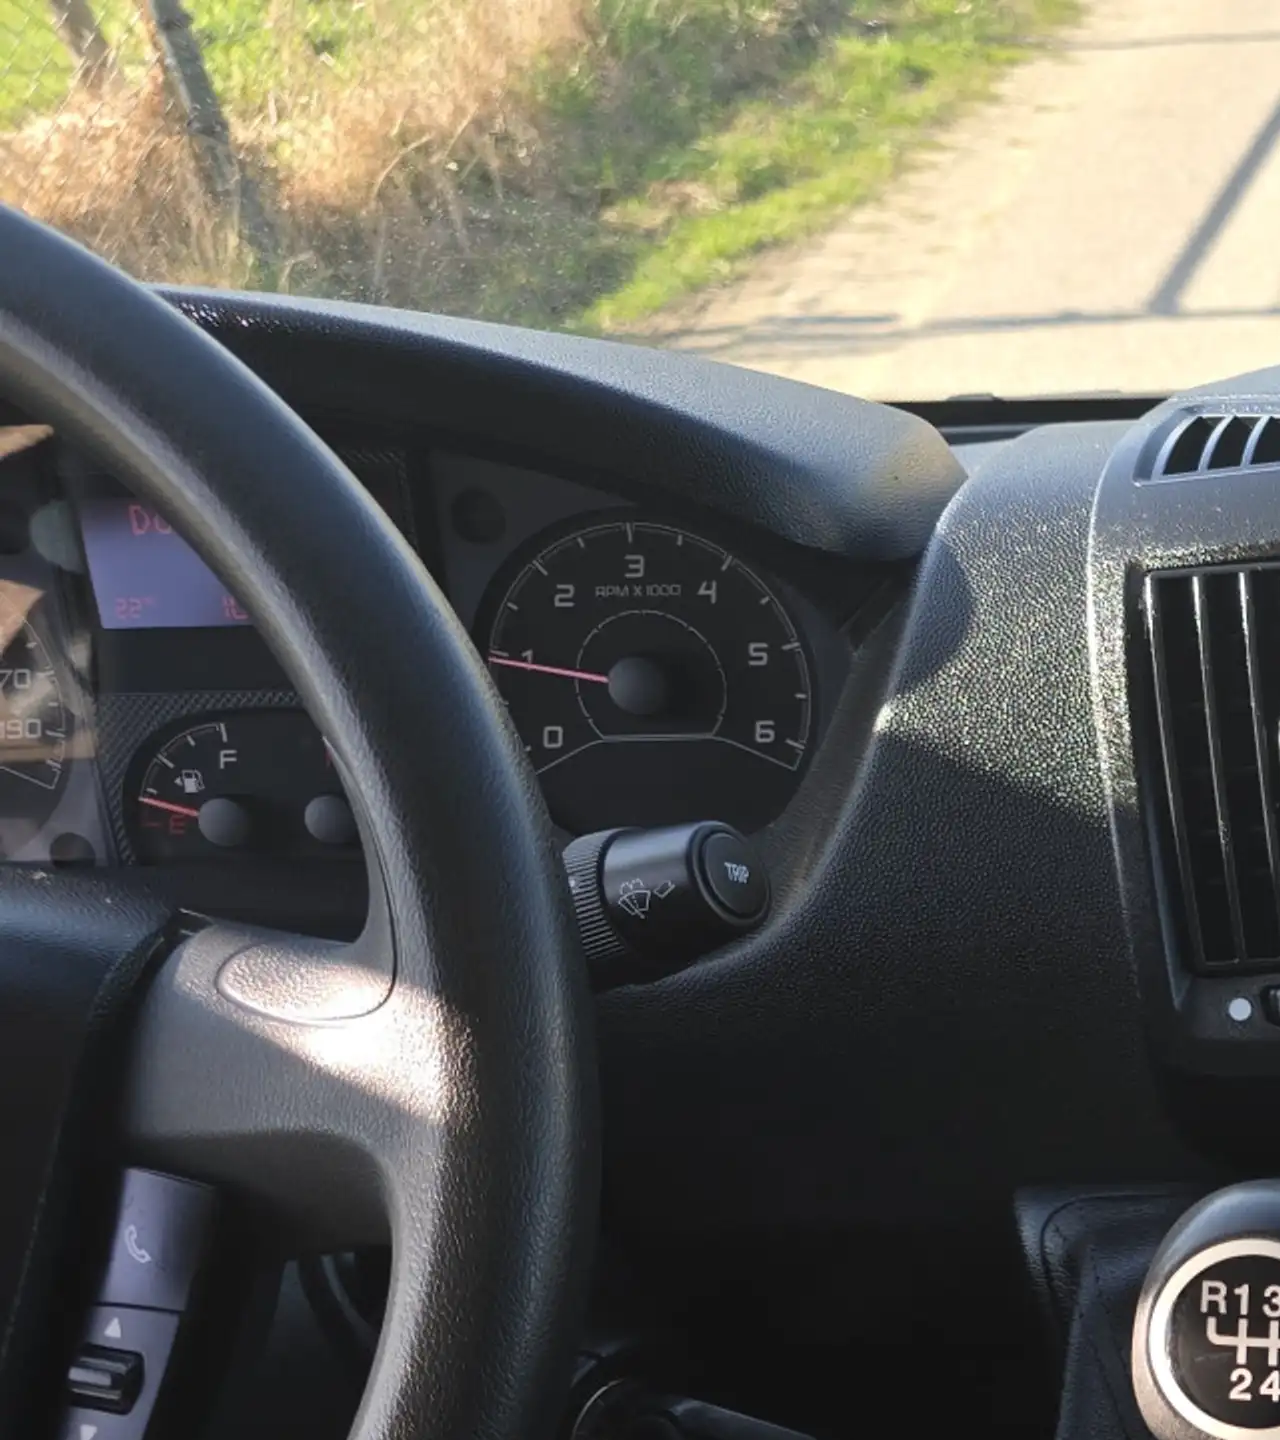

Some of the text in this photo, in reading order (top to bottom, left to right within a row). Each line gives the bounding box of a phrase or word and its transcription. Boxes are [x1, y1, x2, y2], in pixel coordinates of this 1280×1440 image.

[624, 554, 645, 579] 3
[554, 584, 576, 608] 2
[595, 585, 629, 598] RPM
[646, 584, 682, 598] 1000
[697, 580, 718, 605] 4
[747, 643, 769, 666] 5
[542, 725, 564, 749] 0
[754, 720, 776, 743] 6
[219, 749, 238, 769] F
[724, 862, 750, 884] TRIP
[1200, 1280, 1228, 1314] R
[1233, 1284, 1250, 1316] 1
[1228, 1368, 1253, 1401] 2
